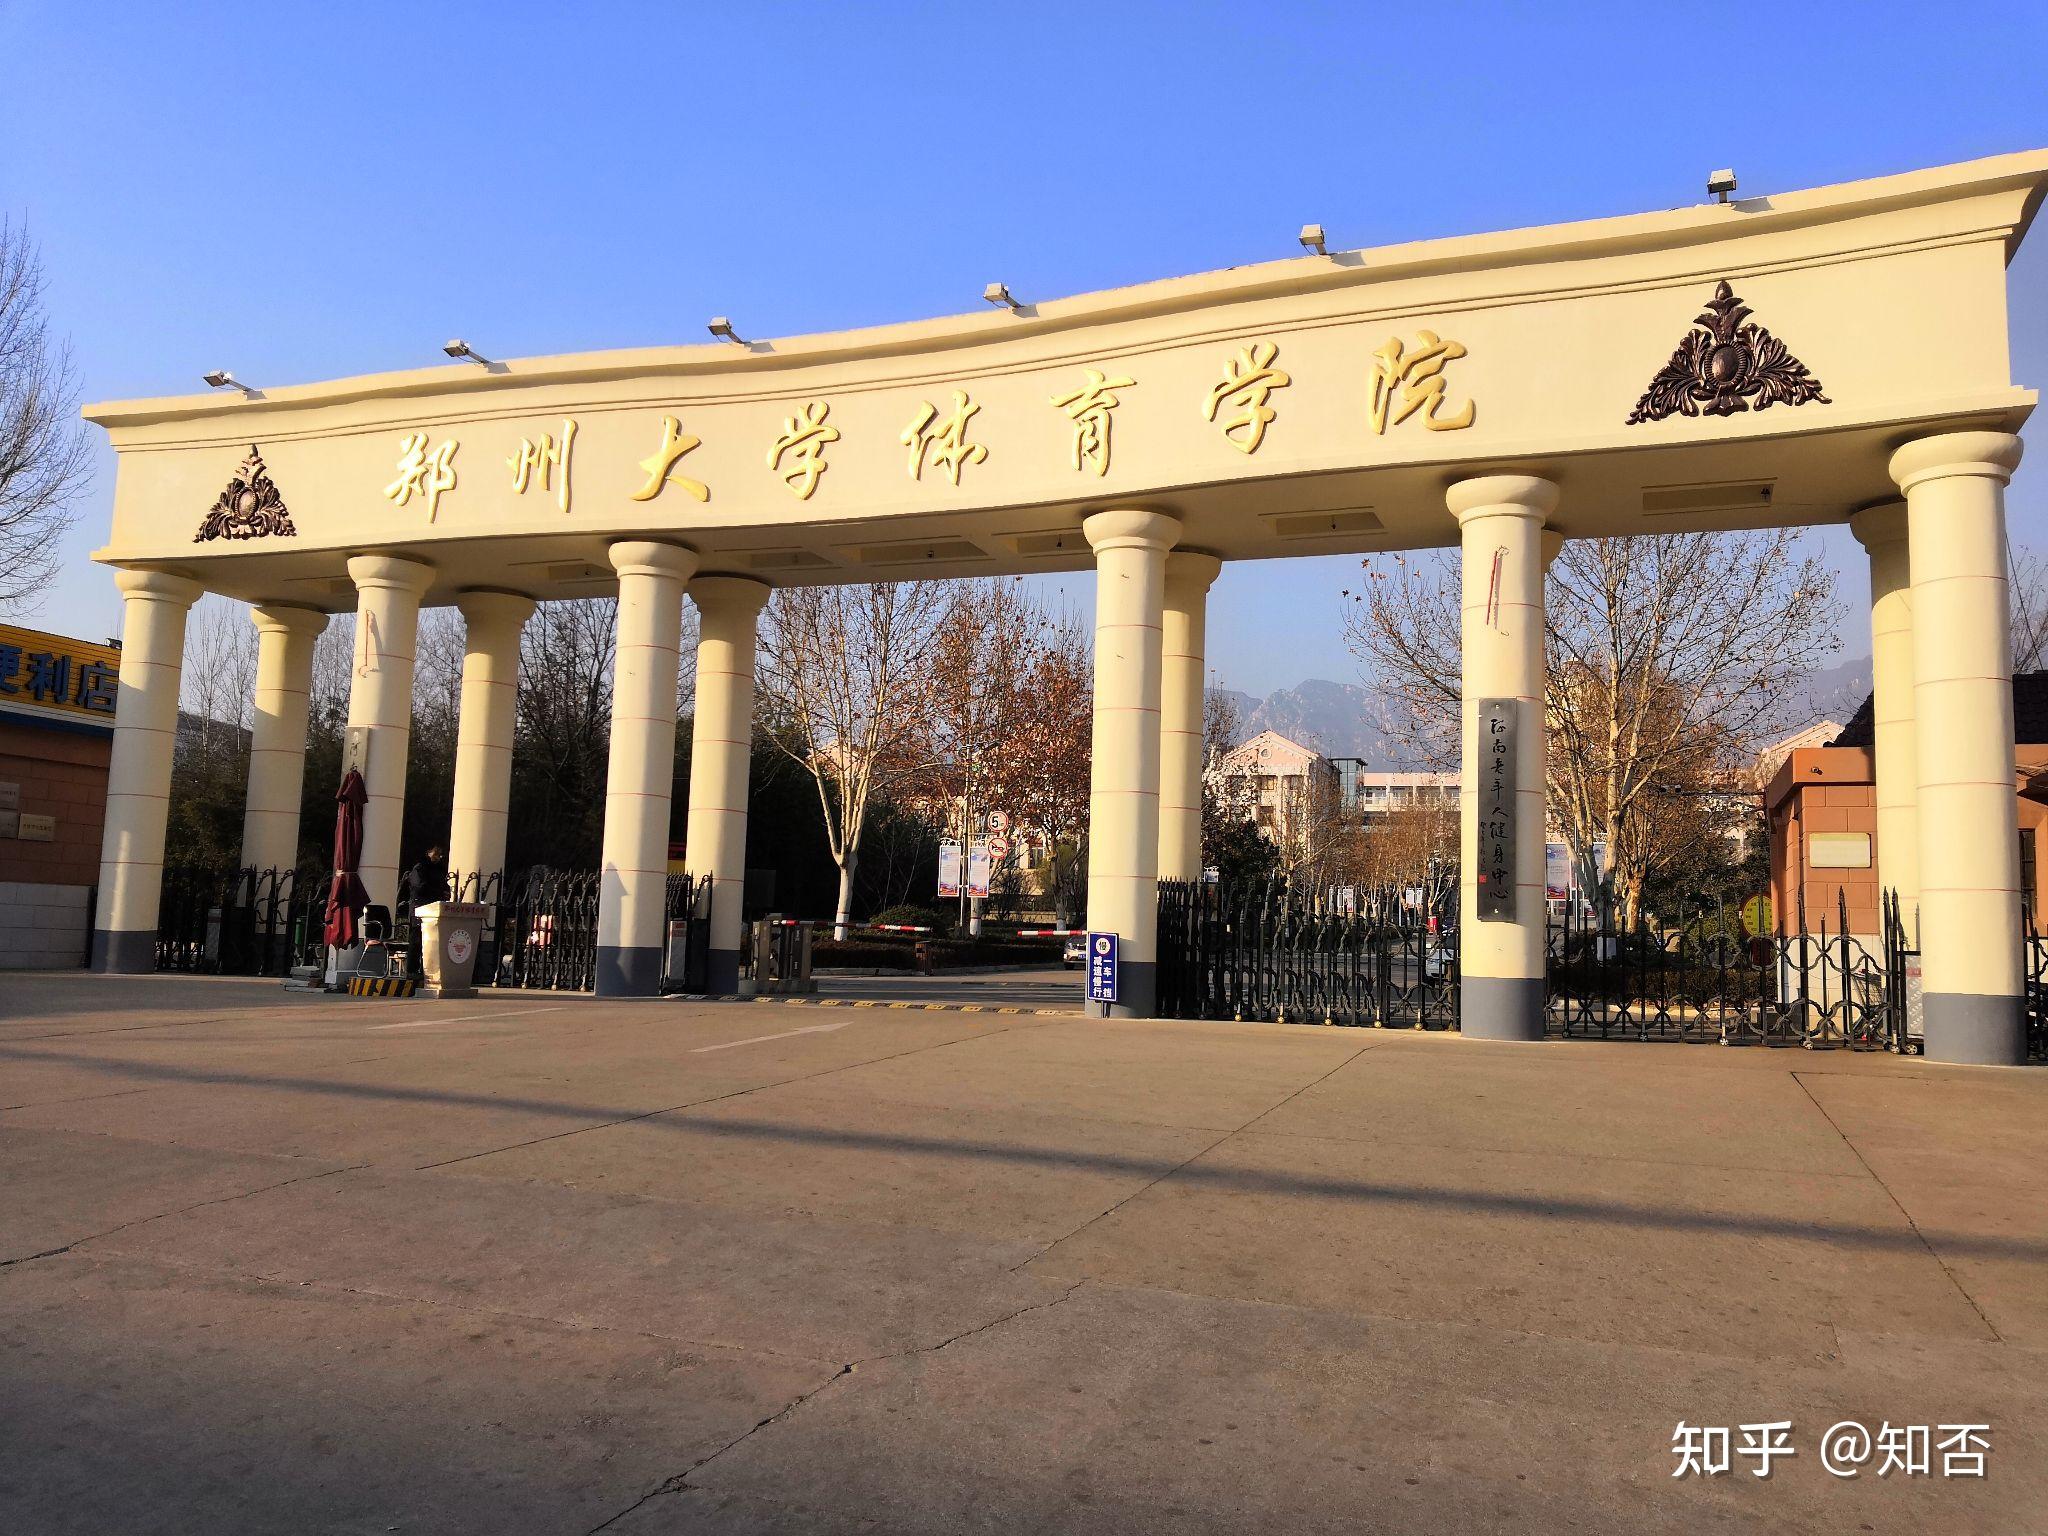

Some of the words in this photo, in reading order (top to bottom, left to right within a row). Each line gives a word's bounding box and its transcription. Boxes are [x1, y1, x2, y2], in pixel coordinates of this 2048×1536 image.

[383, 329, 1476, 524] 郑州大学体育学院
[1093, 956, 1102, 998] 减速慢行
